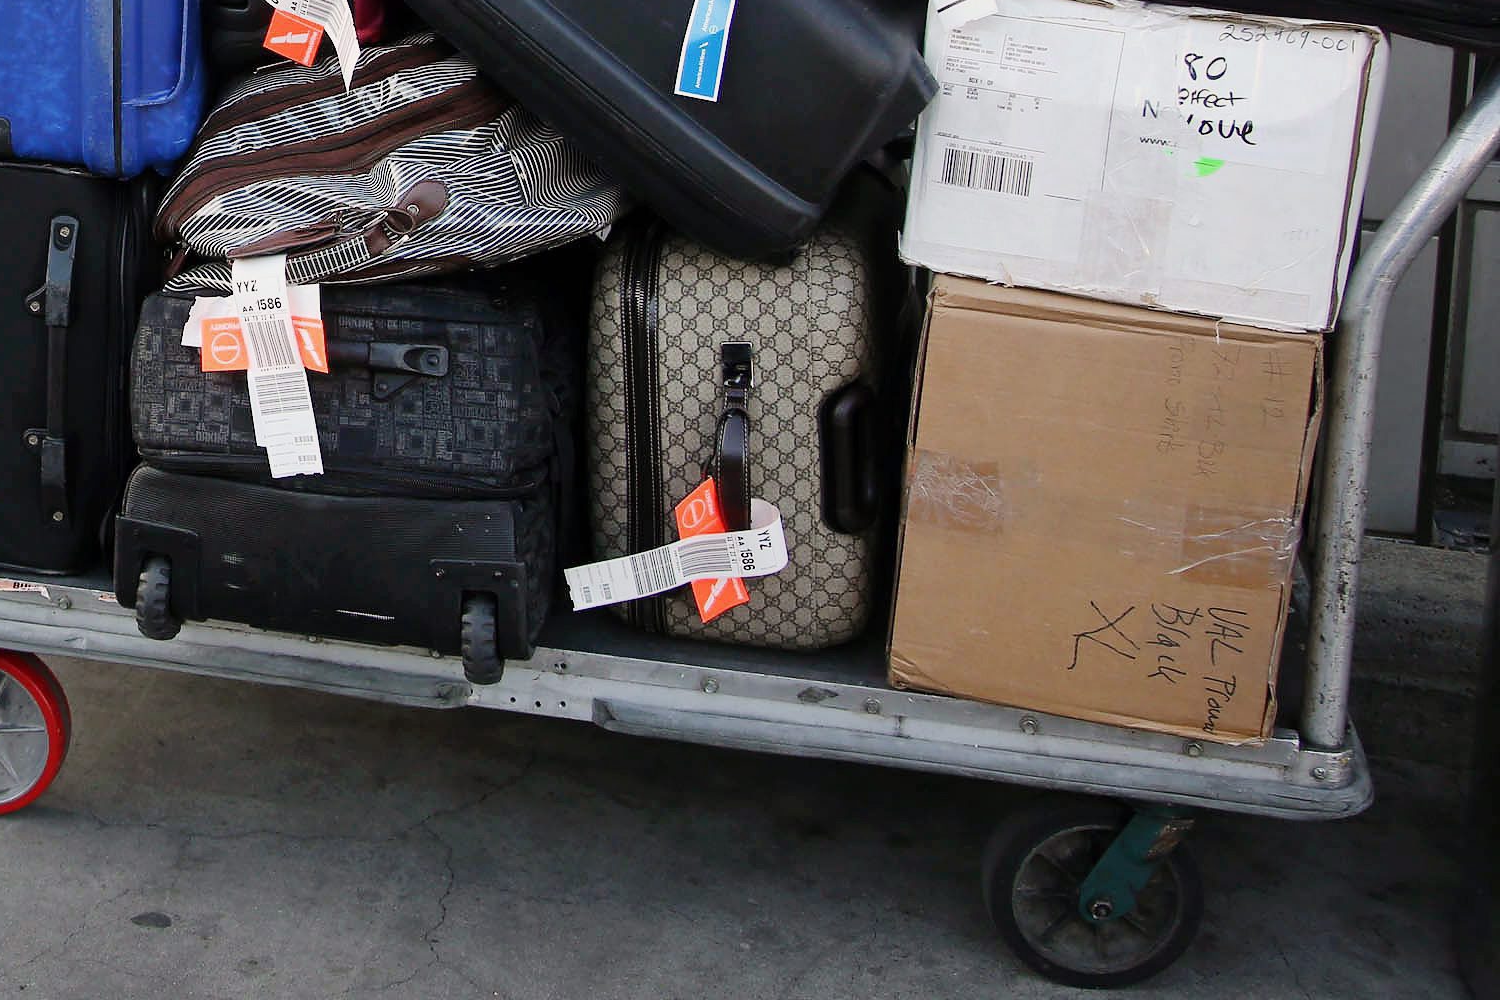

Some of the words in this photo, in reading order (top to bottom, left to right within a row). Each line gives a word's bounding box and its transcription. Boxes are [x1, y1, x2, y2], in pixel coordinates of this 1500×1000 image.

[236, 280, 258, 292] YYZ
[257, 297, 282, 310] 1586
[738, 536, 745, 546] AA
[758, 530, 772, 550] YYZ
[740, 548, 756, 571] 1586
